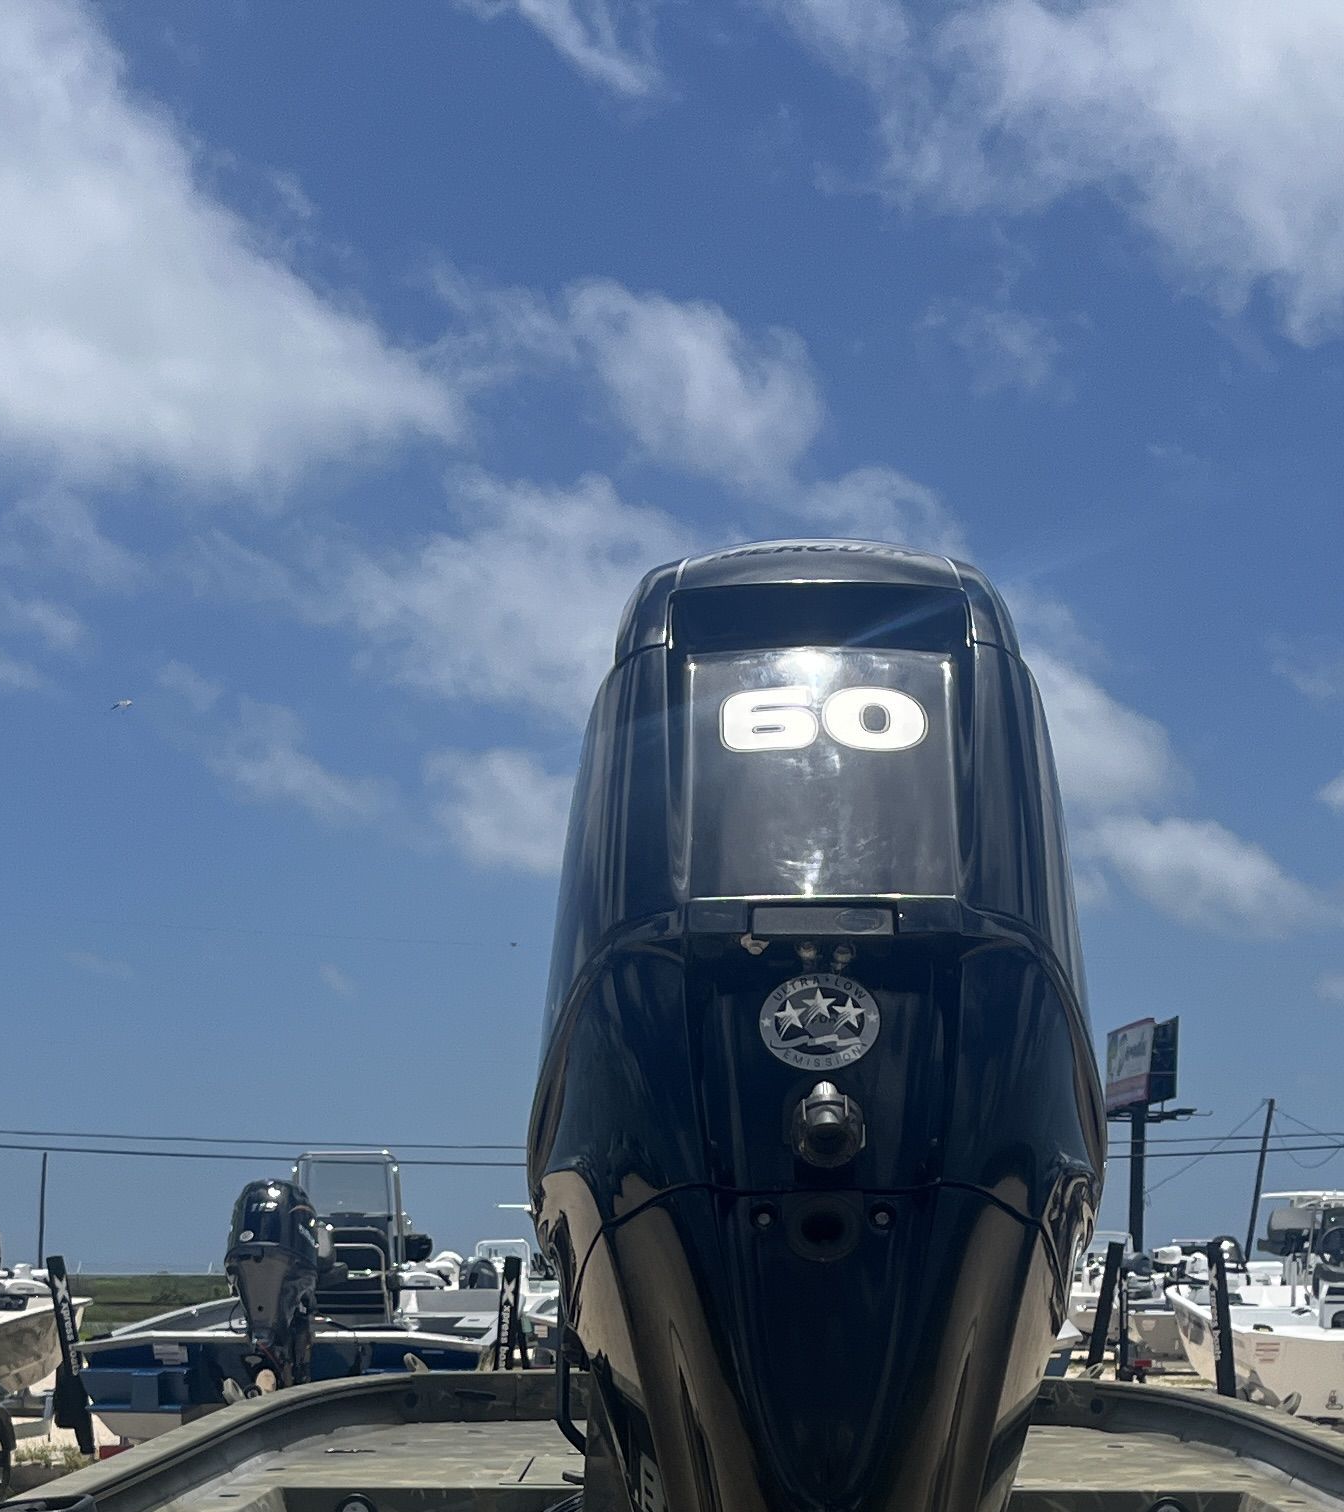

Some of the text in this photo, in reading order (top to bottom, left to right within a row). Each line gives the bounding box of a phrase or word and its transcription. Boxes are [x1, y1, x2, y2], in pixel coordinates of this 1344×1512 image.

[719, 684, 928, 752] 60
[773, 975, 867, 1002] ULTRA LOW
[783, 1046, 862, 1068] EMISSION
